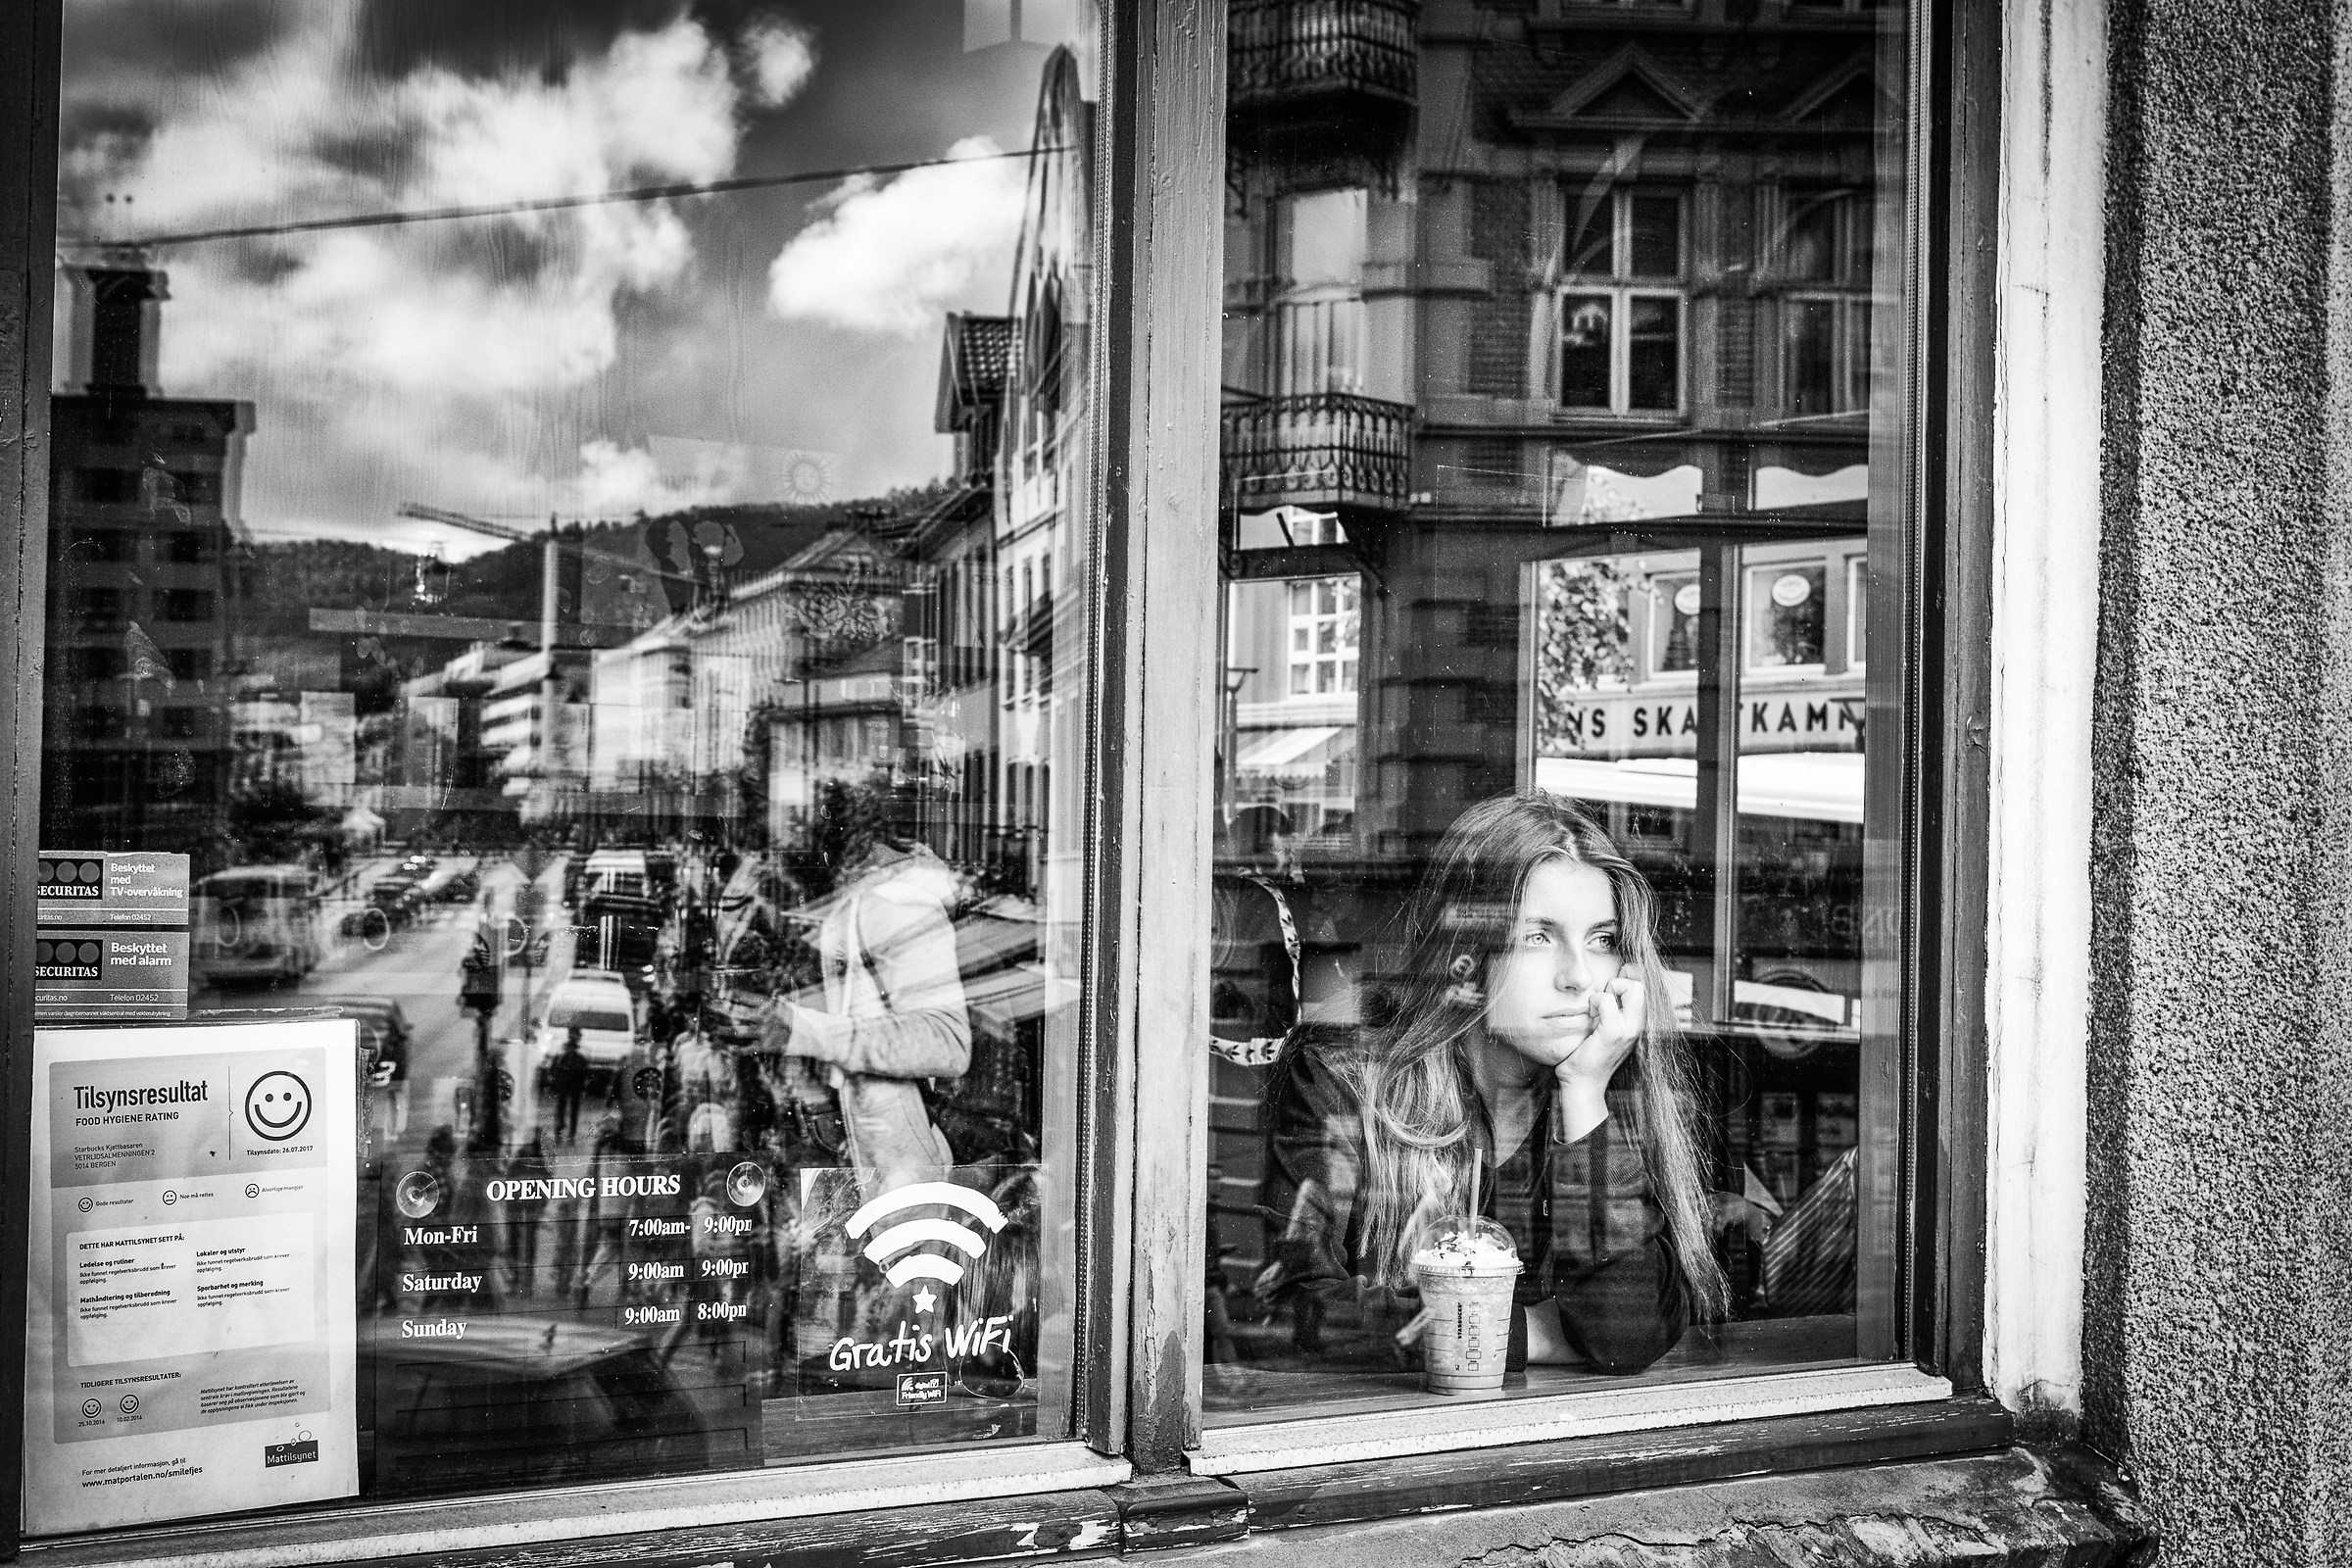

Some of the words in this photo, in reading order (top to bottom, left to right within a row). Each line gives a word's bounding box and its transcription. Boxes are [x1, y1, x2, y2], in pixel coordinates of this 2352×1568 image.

[111, 863, 155, 874] Beskyttet
[111, 887, 183, 898] TV-overvåkning
[111, 943, 168, 955] Beskyttet
[111, 956, 136, 965] med
[139, 956, 172, 965] alarm
[74, 1080, 208, 1113] Tilsynsresultat
[76, 1117, 100, 1126] FOOD
[103, 1114, 143, 1124] HYGIENE
[145, 1112, 178, 1121] RATING
[106, 1143, 143, 1152] Kjøttbasaren
[486, 1177, 595, 1201] OPENING
[601, 1175, 680, 1198] HOURS
[404, 1225, 478, 1246] Mon-Fri
[628, 1219, 690, 1236] 7:00am-
[116, 1238, 157, 1247] MATTILSYNET
[402, 1274, 482, 1295] Saturday
[628, 1262, 684, 1281] 9:00am
[80, 1295, 124, 1303] Mathåndtering
[402, 1320, 466, 1339] Sunday
[624, 1306, 680, 1326] 9:00am
[830, 1321, 932, 1370] Gratis
[946, 1314, 1014, 1358] WiFi
[115, 1372, 181, 1385] TILSYNSRESULTATER:
[268, 1451, 316, 1463] Mattilsynet
[134, 1460, 171, 1469] informasjon,
[82, 1466, 203, 1488] www.matportalen.no/smilefjes
